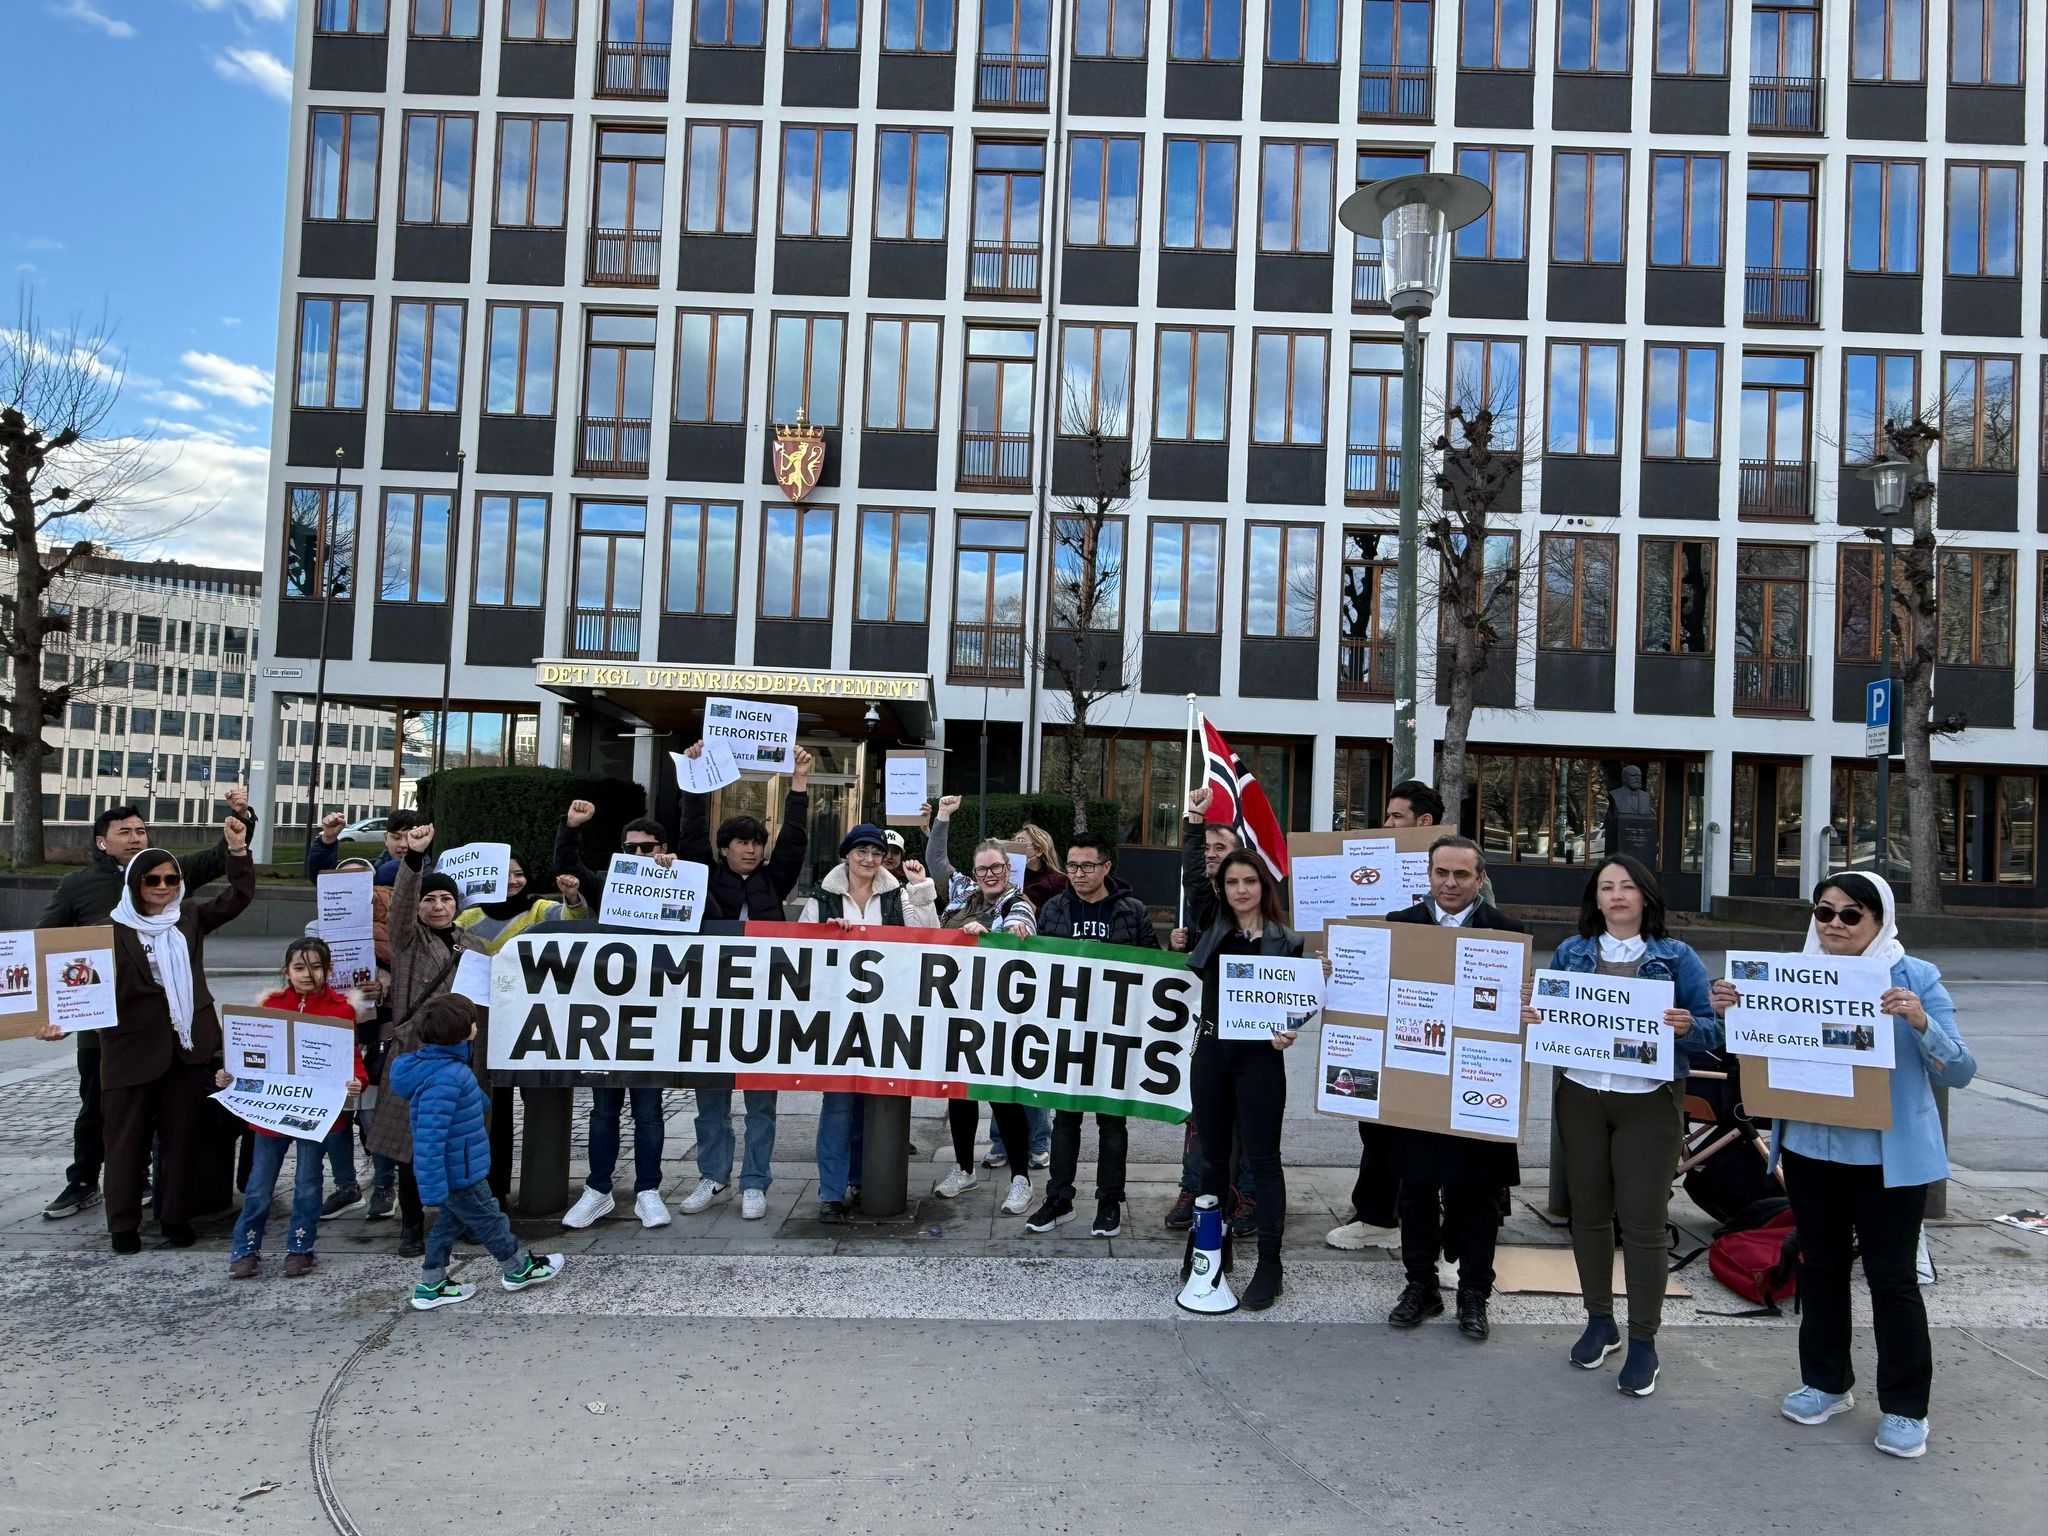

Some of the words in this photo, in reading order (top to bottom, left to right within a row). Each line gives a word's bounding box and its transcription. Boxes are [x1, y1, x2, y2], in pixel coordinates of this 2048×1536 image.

[542, 665, 589, 684] DET
[592, 666, 640, 687] KGL.
[648, 669, 919, 698] UTENRIKSDEPARTEMENT
[1873, 688, 1885, 721] P
[735, 710, 772, 723] INGEN
[708, 725, 788, 743] TERRORISTER
[203, 767, 209, 779] P
[446, 851, 480, 867] INGEN
[450, 866, 499, 881] ORISTER
[641, 866, 678, 880] INGEN
[611, 882, 695, 901] TERRORISTER
[612, 907, 631, 918] VÅRE
[634, 911, 659, 920] GATER
[1259, 968, 1296, 982] INGEN
[1775, 967, 1839, 986] INGEN
[517, 940, 885, 1004] WOMEN'S
[918, 953, 1192, 1033] RIGHTS
[1576, 986, 1630, 1005] INGEN
[1227, 990, 1318, 1007] TERRORISTER
[1737, 993, 1875, 1018] TERRORISTER
[1232, 1018, 1256, 1029] VÅRE
[1259, 1022, 1286, 1031] GATER
[1537, 1008, 1659, 1035] TERRORISTER
[1735, 1030, 1739, 1040] I
[1742, 1029, 1774, 1043] VÅRE
[1777, 1034, 1819, 1048] GATER
[509, 1003, 658, 1061] ARE
[678, 1006, 925, 1070] HUMAN
[945, 1017, 1184, 1095] RIGHTS
[1535, 1041, 1539, 1050] I
[1542, 1041, 1571, 1054] VÅRE
[1574, 1046, 1610, 1059] GATER
[266, 1084, 313, 1098] INGEN
[227, 1095, 329, 1118] TERRORISTER
